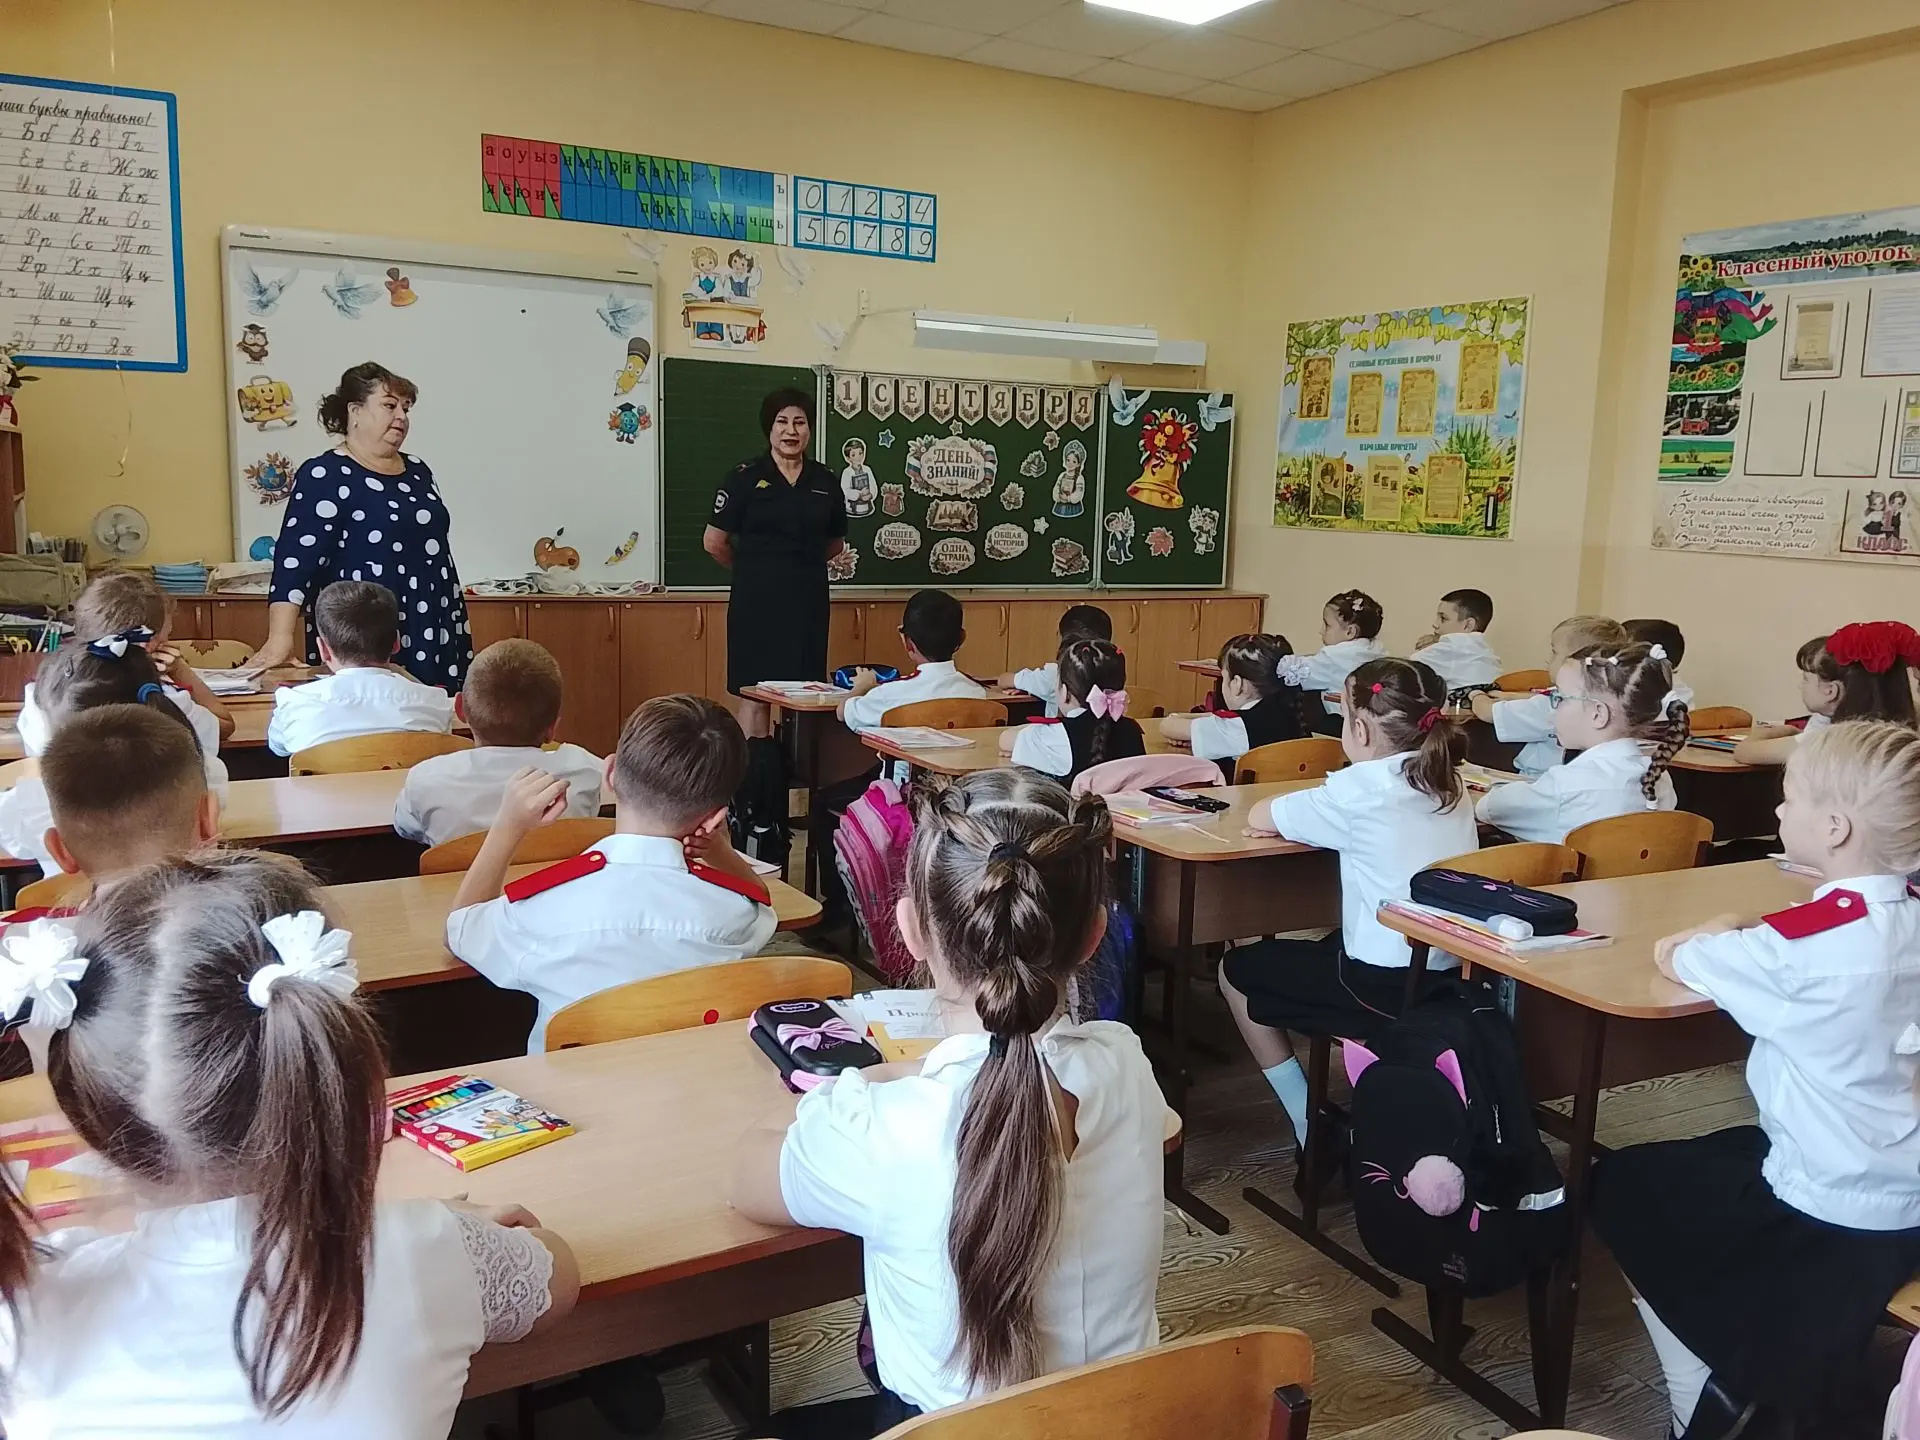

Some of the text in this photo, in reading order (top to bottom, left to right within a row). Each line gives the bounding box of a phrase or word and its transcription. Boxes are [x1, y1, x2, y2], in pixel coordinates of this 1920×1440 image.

[0, 97, 152, 126] иши буквы правильно!
[1717, 245, 1913, 277] Классный уголок
[843, 380, 1088, 413] 1 СЕНТЯБРЯ
[934, 449, 972, 464] ДЕНЬ
[927, 465, 979, 481] ЗНАНИЙ!
[884, 530, 913, 539] ОБЩЕЕ
[994, 531, 1023, 540] ОБЩАЯ
[883, 537, 917, 547] БУДУЩЕЕ
[993, 538, 1025, 547] ИСТОРИЯ
[941, 543, 969, 553] ОДНА
[937, 552, 971, 562] СТРАНА
